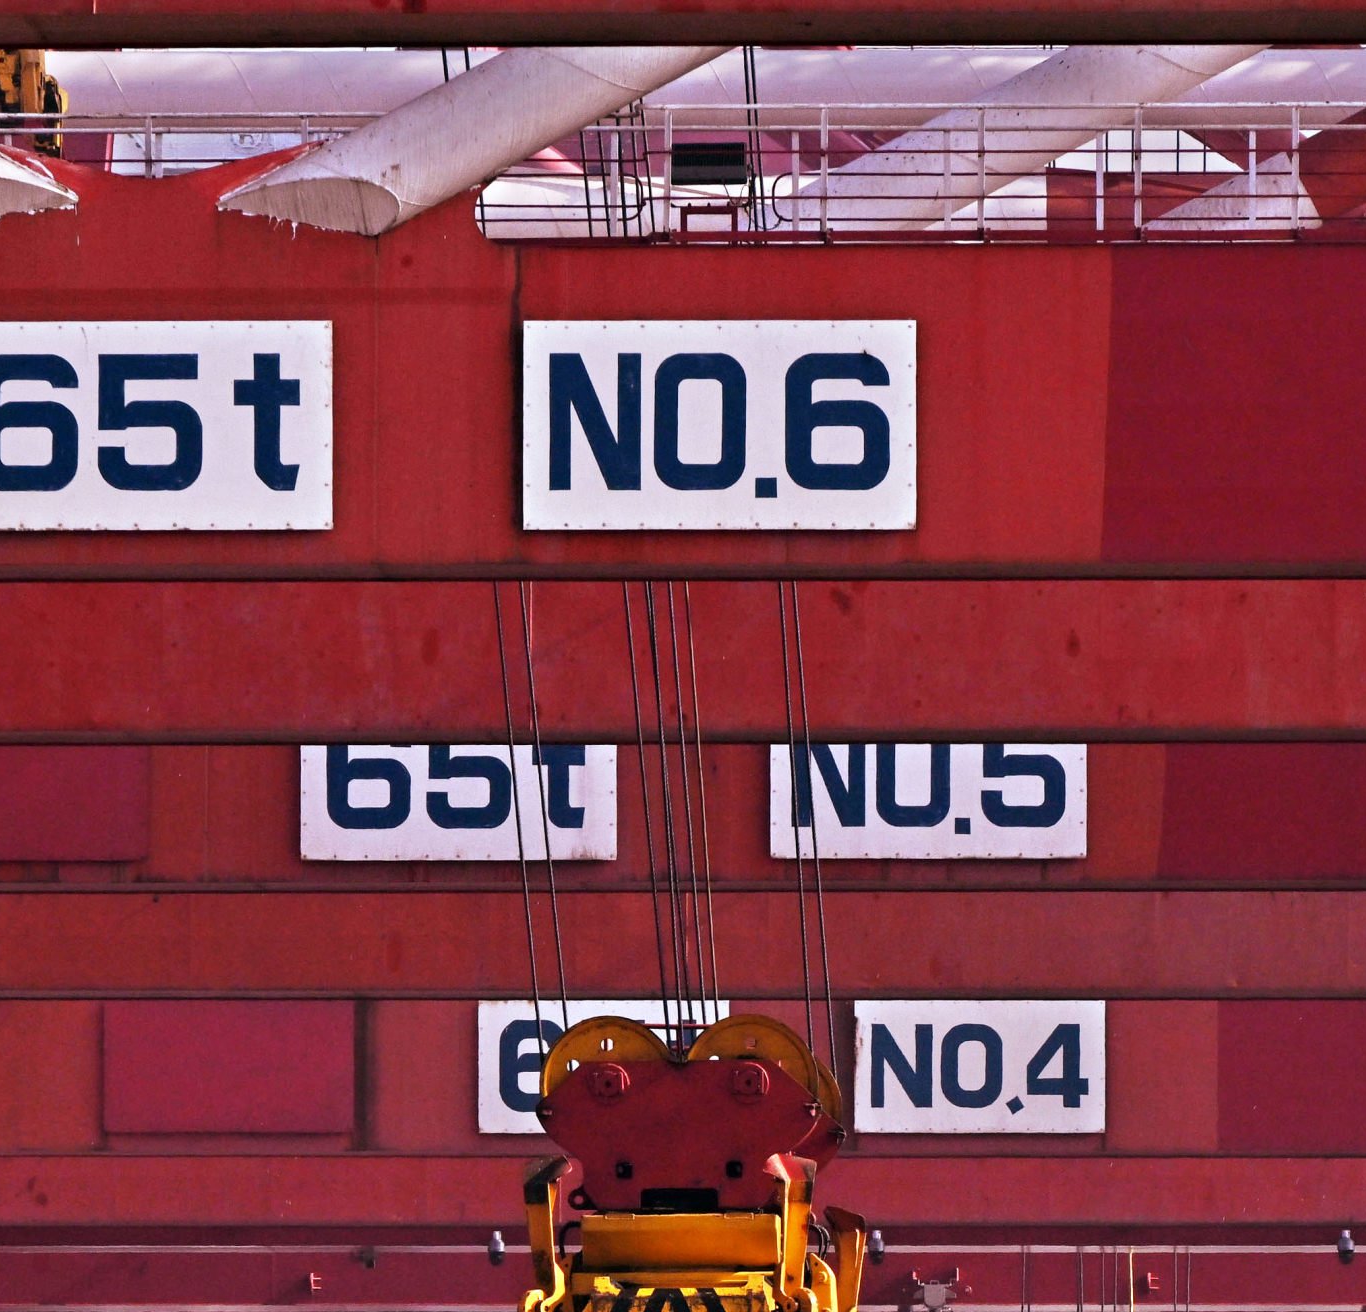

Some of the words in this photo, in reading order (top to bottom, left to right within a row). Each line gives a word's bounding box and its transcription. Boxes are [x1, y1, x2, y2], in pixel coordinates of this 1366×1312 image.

[549, 353, 890, 498] NO.6
[327, 746, 585, 829] 65t
[794, 746, 1065, 834] NO.5
[871, 1024, 1088, 1114] NO.4
